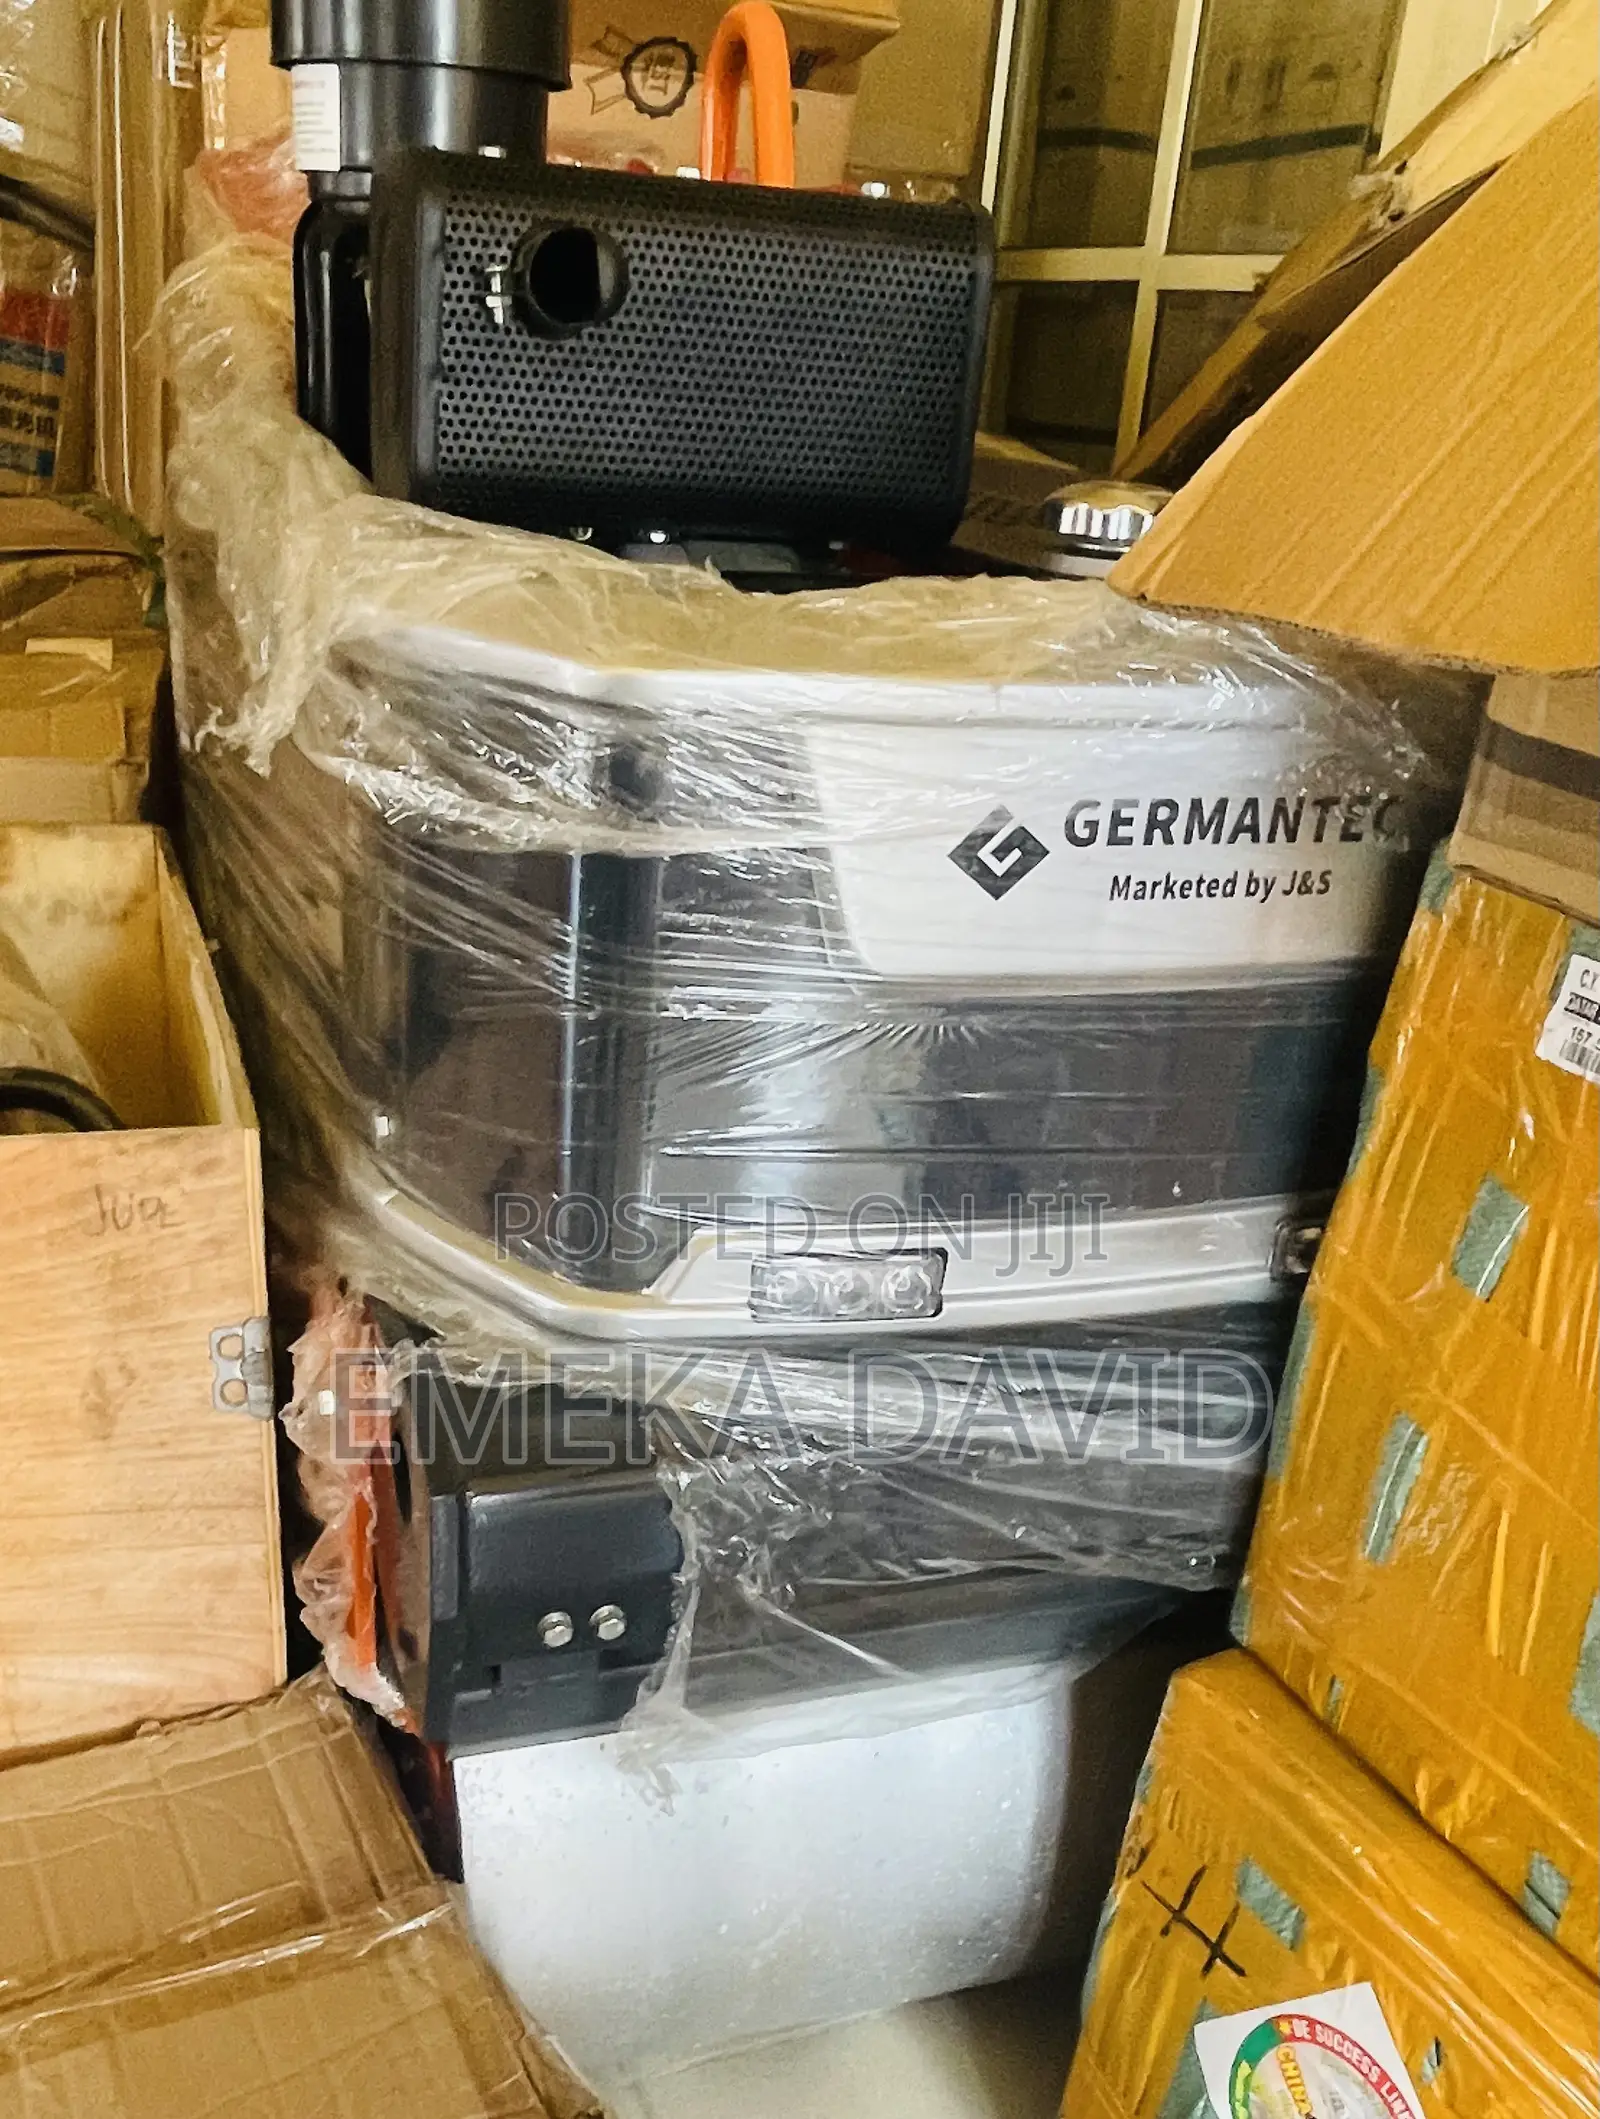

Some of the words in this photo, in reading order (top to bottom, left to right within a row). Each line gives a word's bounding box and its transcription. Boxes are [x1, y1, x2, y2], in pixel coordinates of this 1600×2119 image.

[1109, 870, 1239, 901] Marketed
[1244, 868, 1277, 904] by
[1281, 869, 1333, 896] J&S
[1315, 2023, 1381, 2083] SUCCESS
